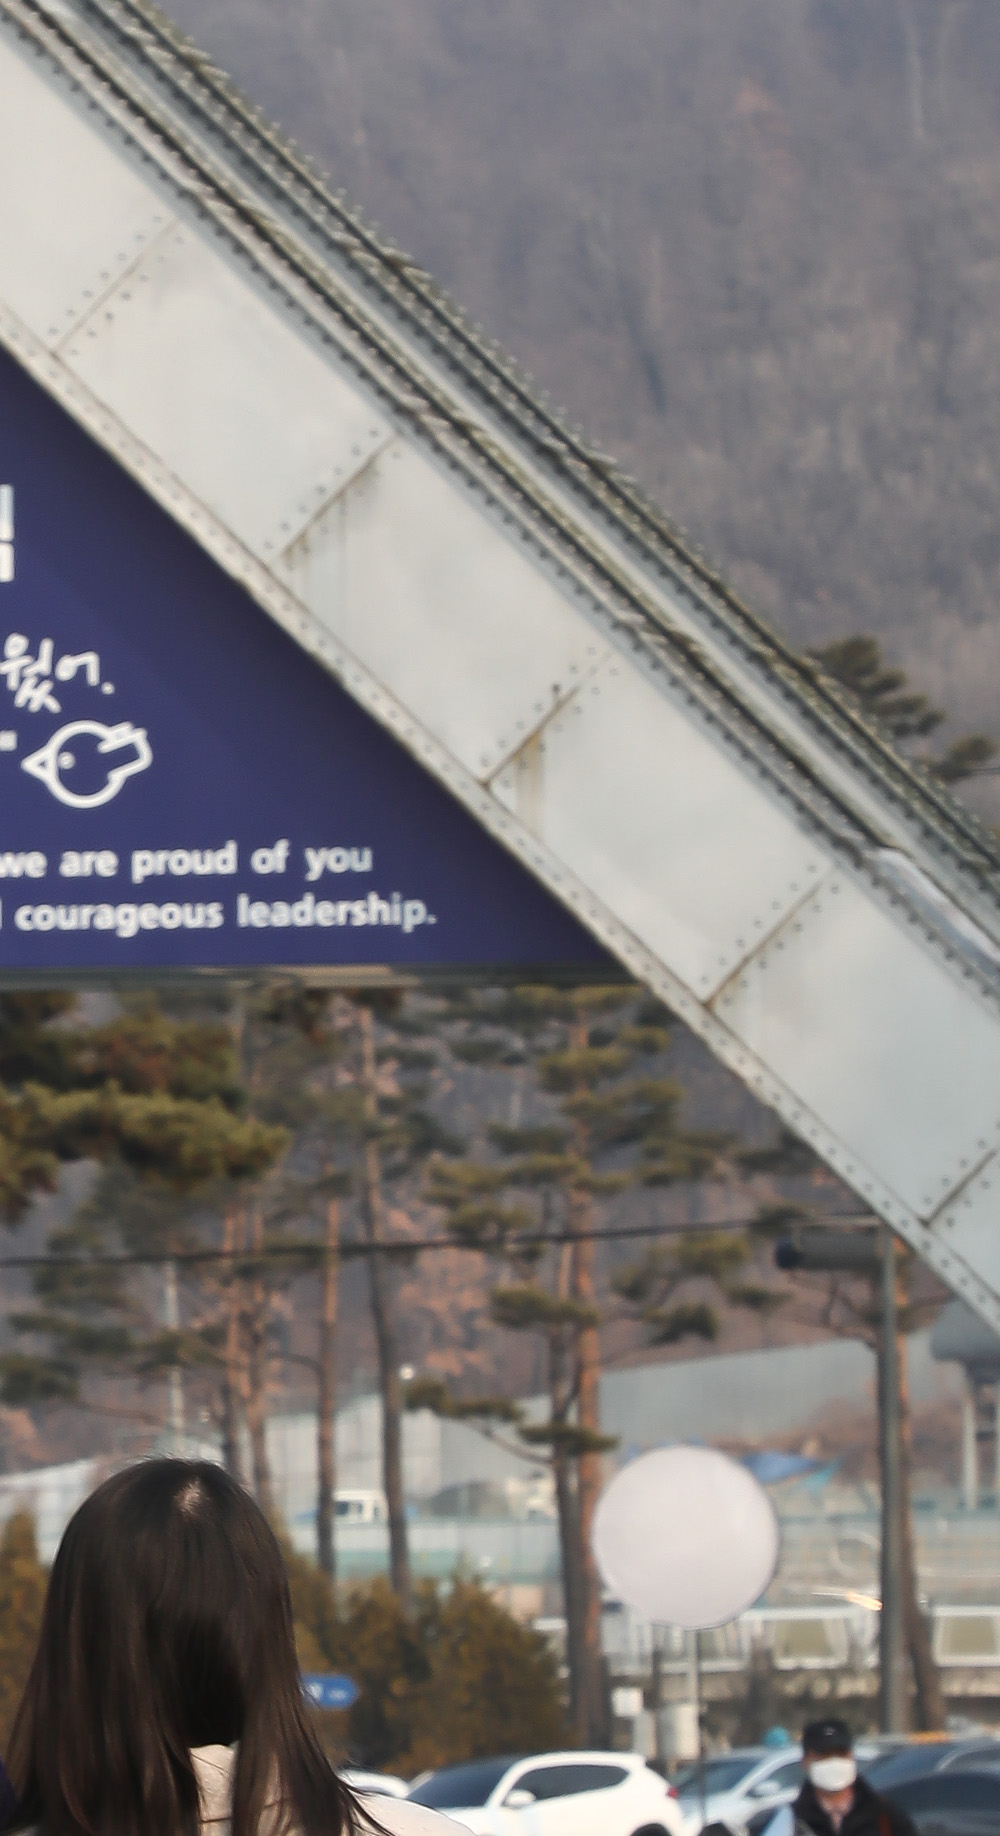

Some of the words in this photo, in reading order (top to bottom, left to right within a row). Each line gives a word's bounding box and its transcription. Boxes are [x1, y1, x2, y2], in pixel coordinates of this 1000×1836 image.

[58, 849, 120, 878] are
[130, 839, 240, 884] proud
[250, 838, 291, 875] of
[303, 846, 377, 879] you
[13, 901, 225, 939] courageous
[236, 891, 437, 935] leadership.
